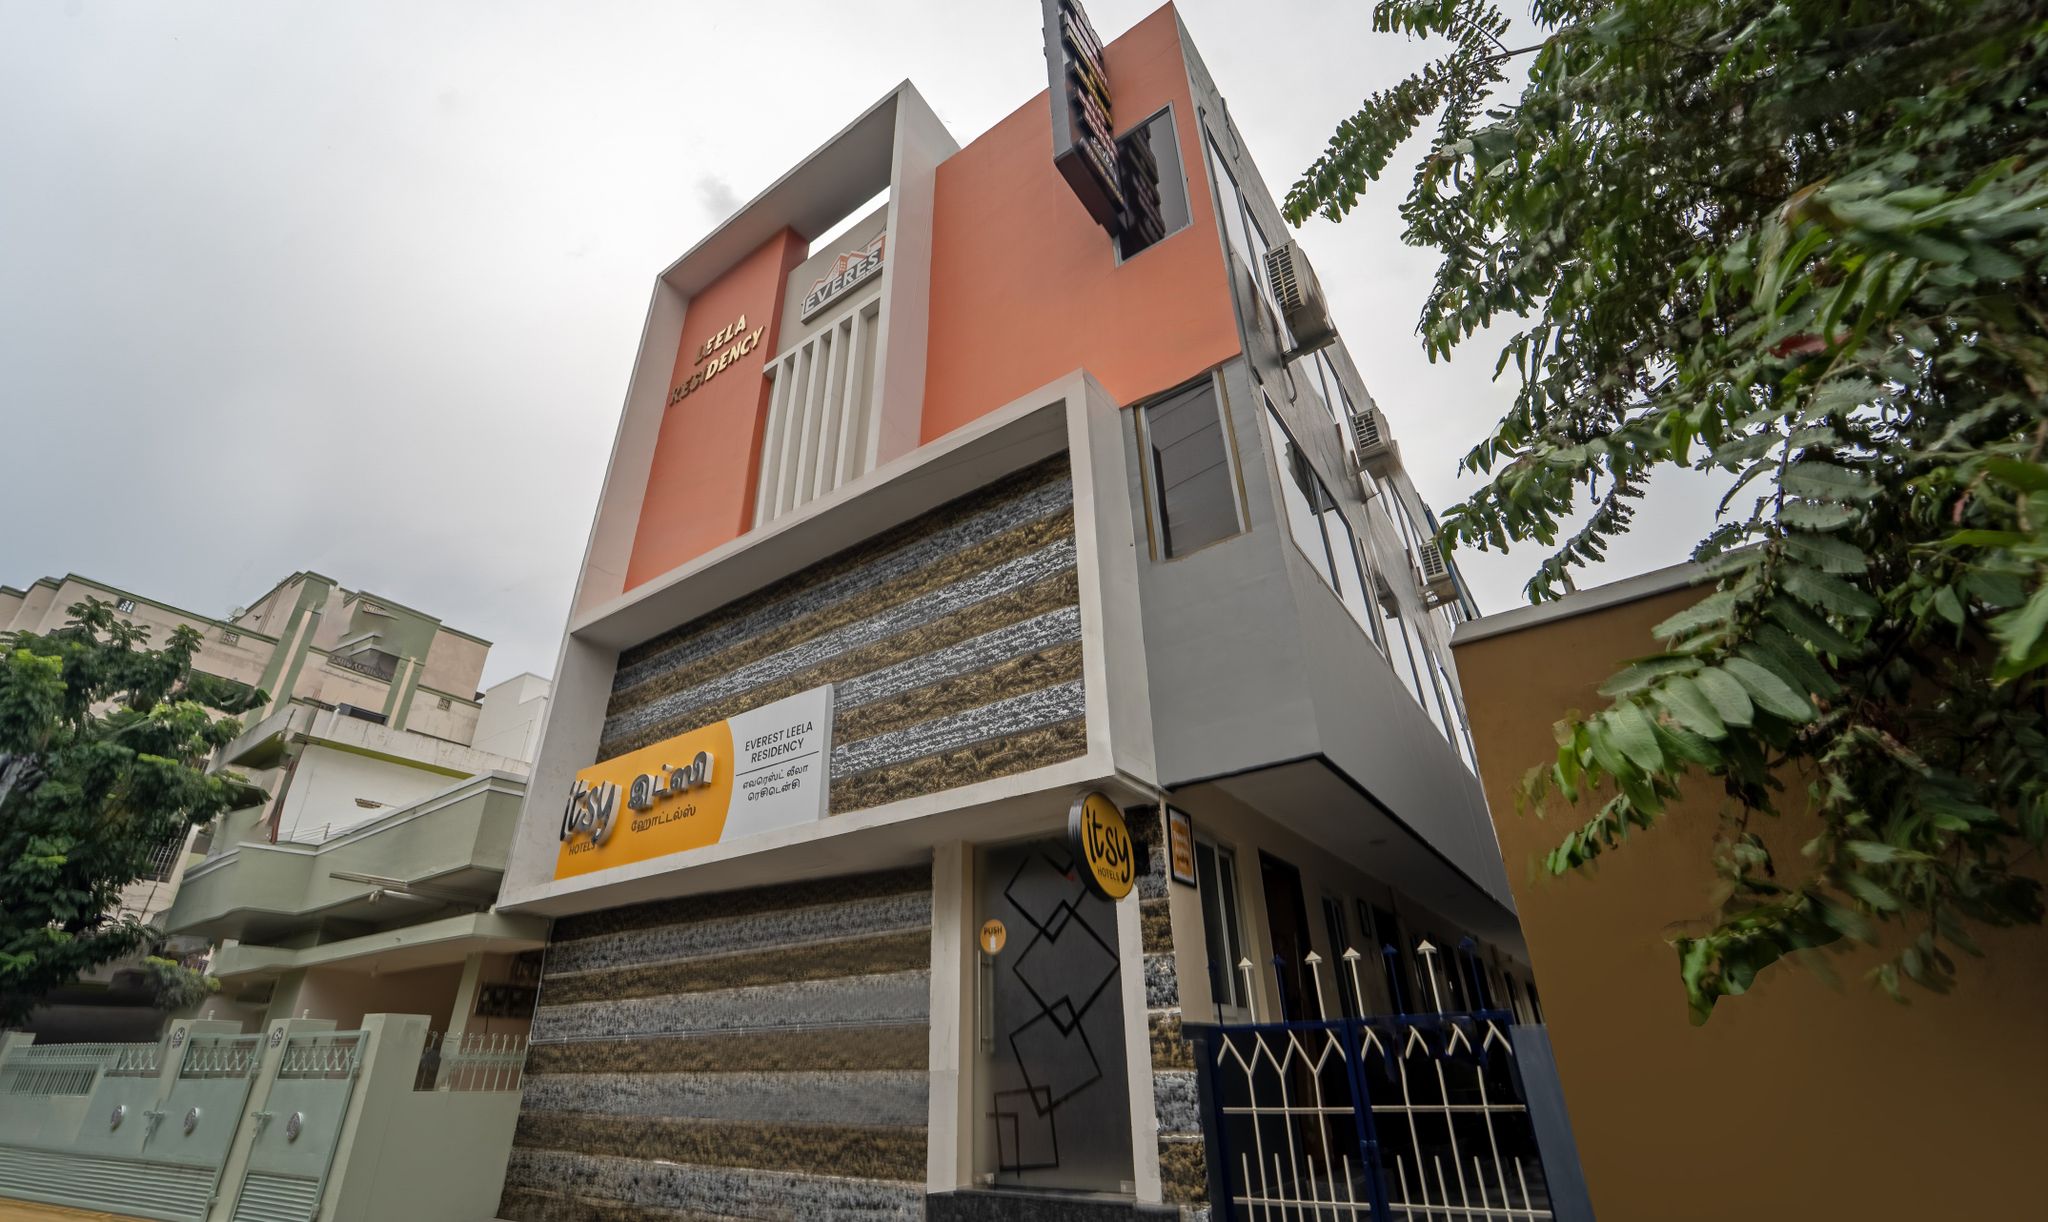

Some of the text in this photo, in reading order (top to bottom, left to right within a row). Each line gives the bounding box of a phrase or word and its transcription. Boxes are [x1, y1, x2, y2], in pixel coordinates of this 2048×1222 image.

[804, 250, 880, 313] EVERES
[695, 313, 746, 366] LEELA
[745, 721, 813, 751] EVEREST LEELA
[751, 738, 804, 764] RESIDENCY
[627, 751, 713, 811] இட்ஸி
[786, 765, 809, 779] லீலா
[560, 778, 620, 845] itsy
[568, 840, 597, 857] HOTELS
[1086, 804, 1131, 884] itsy
[1097, 865, 1121, 883] HOTELS
[982, 924, 1004, 937] PUSH
